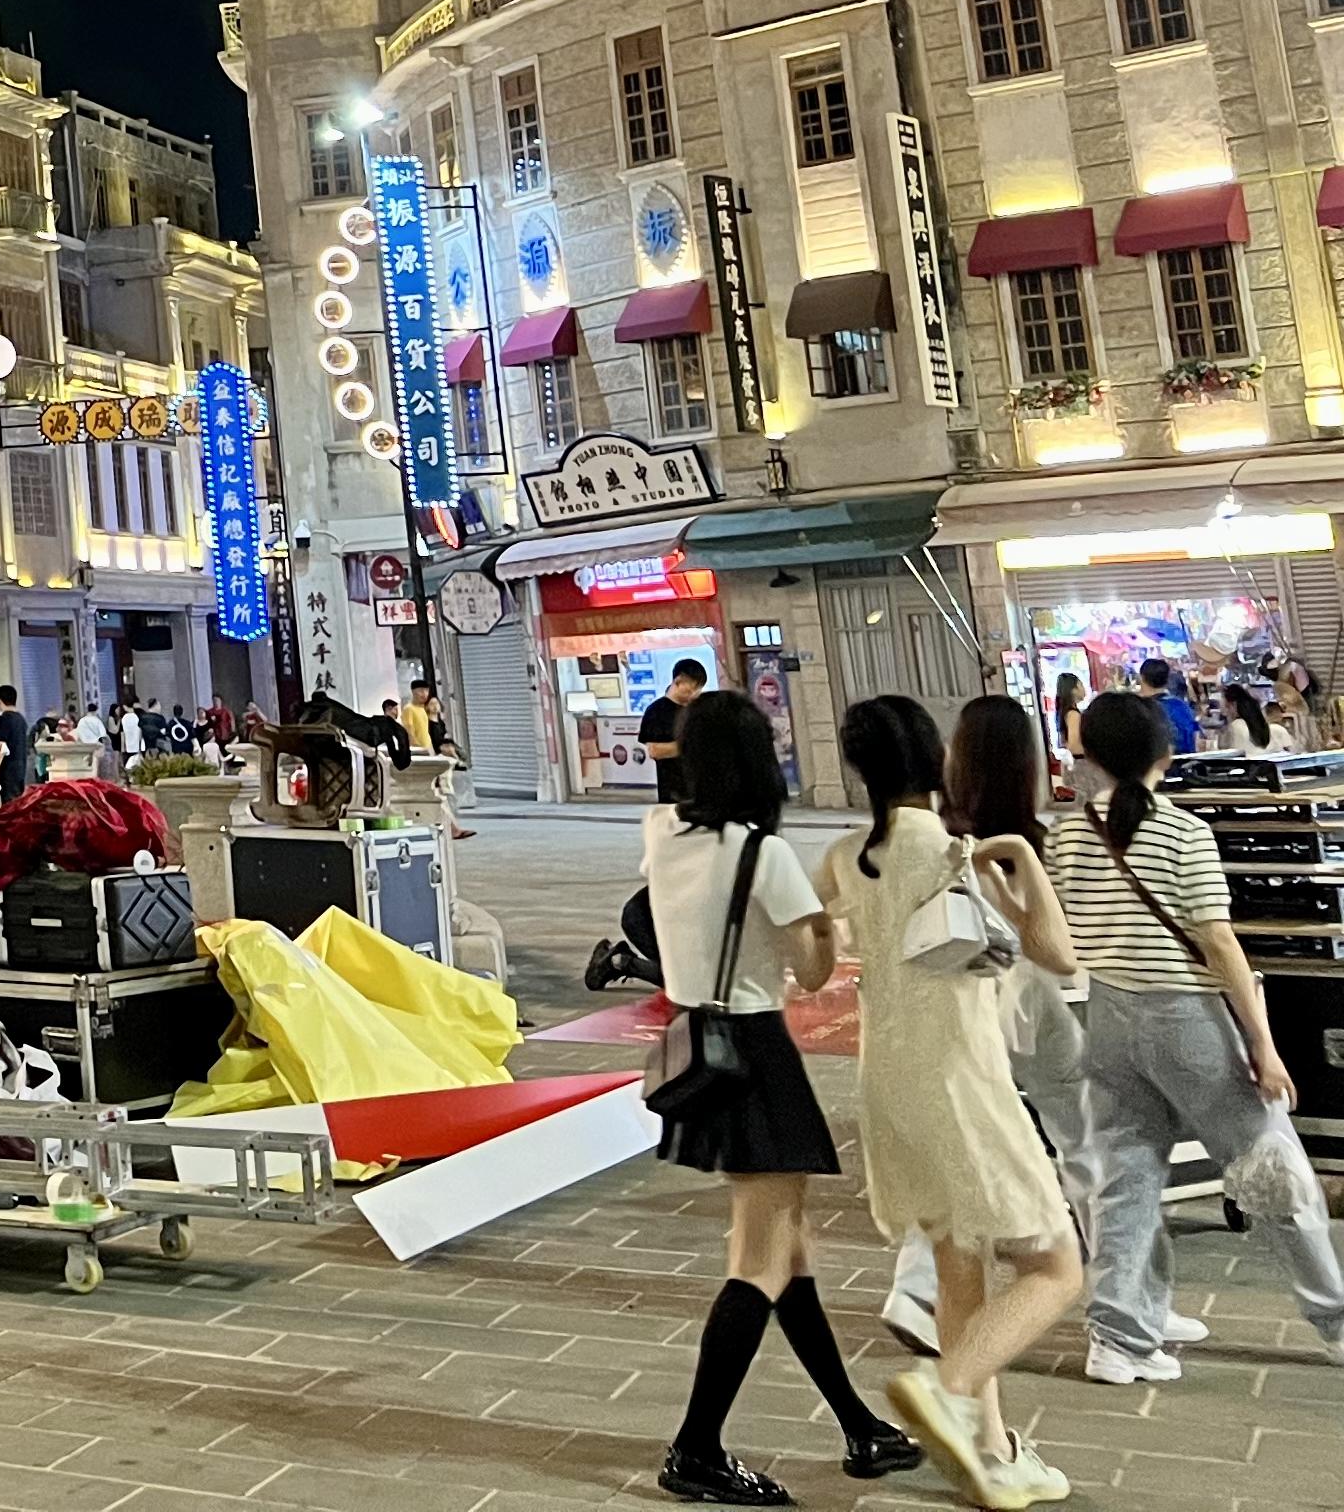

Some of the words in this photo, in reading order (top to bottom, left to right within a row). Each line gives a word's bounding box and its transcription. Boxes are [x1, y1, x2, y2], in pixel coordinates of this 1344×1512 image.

[573, 448, 598, 468] YUAN
[598, 444, 635, 458] ZHONG
[559, 501, 600, 515] PHOTO
[631, 487, 685, 503] STUDIO
